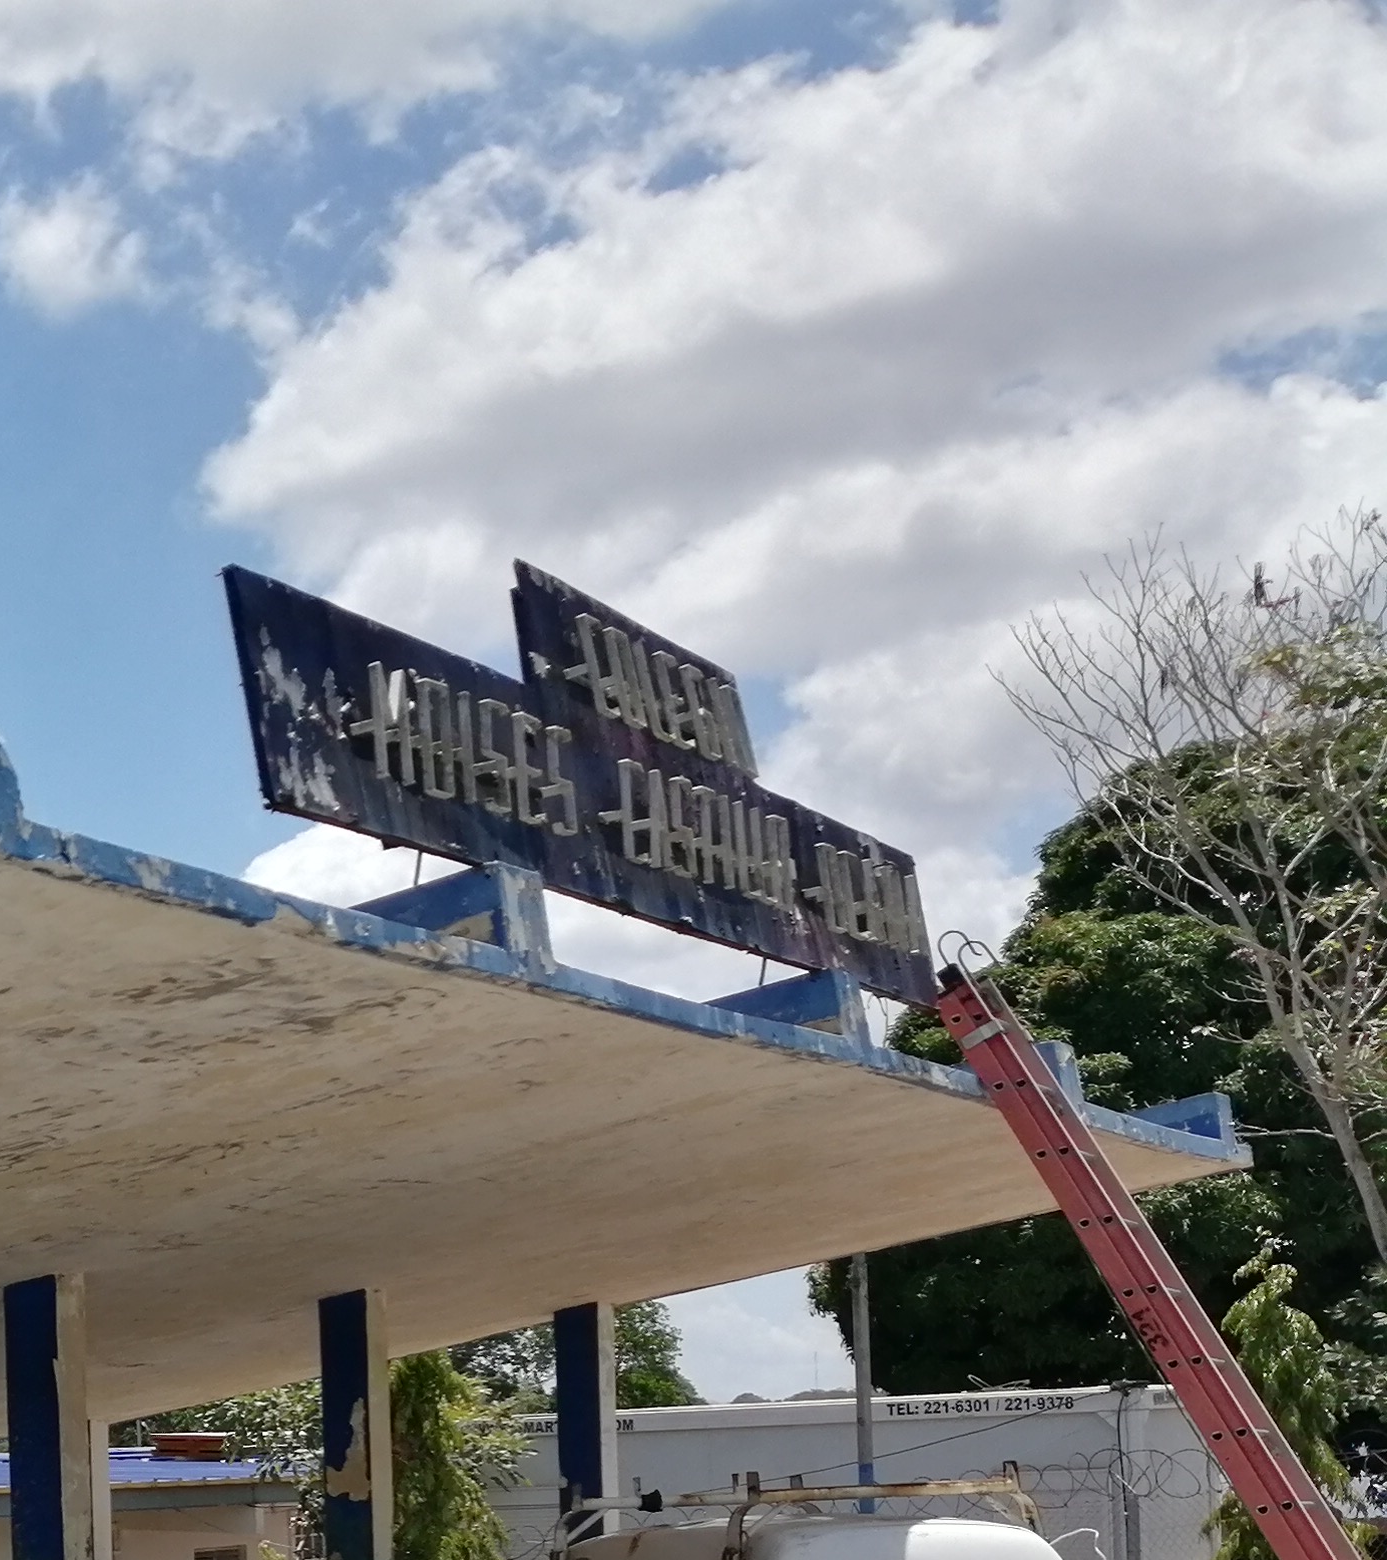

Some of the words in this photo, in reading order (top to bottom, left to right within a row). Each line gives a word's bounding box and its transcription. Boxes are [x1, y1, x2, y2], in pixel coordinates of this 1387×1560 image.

[365, 660, 578, 836] MOISES
[886, 1402, 919, 1416] TEL:
[924, 1399, 990, 1414] 221-6301
[1004, 1396, 1074, 1412] 221-9378
